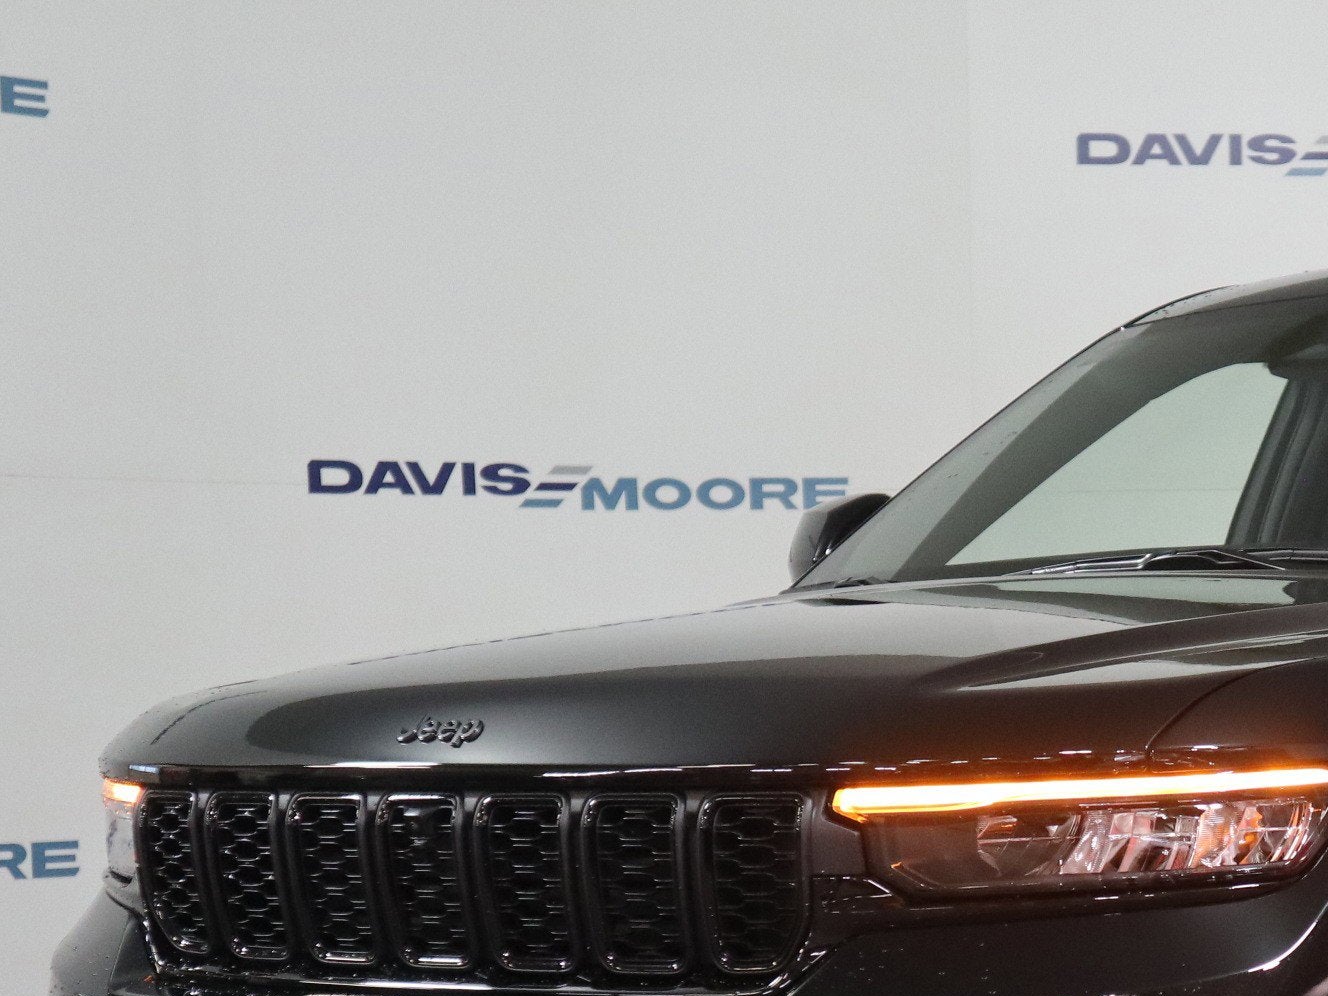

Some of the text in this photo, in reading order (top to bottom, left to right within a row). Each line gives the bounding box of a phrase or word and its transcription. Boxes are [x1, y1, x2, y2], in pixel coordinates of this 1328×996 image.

[1075, 132, 1298, 168] DAVIS
[306, 459, 849, 513] DAVIS MOORE
[396, 714, 486, 748] Jeep
